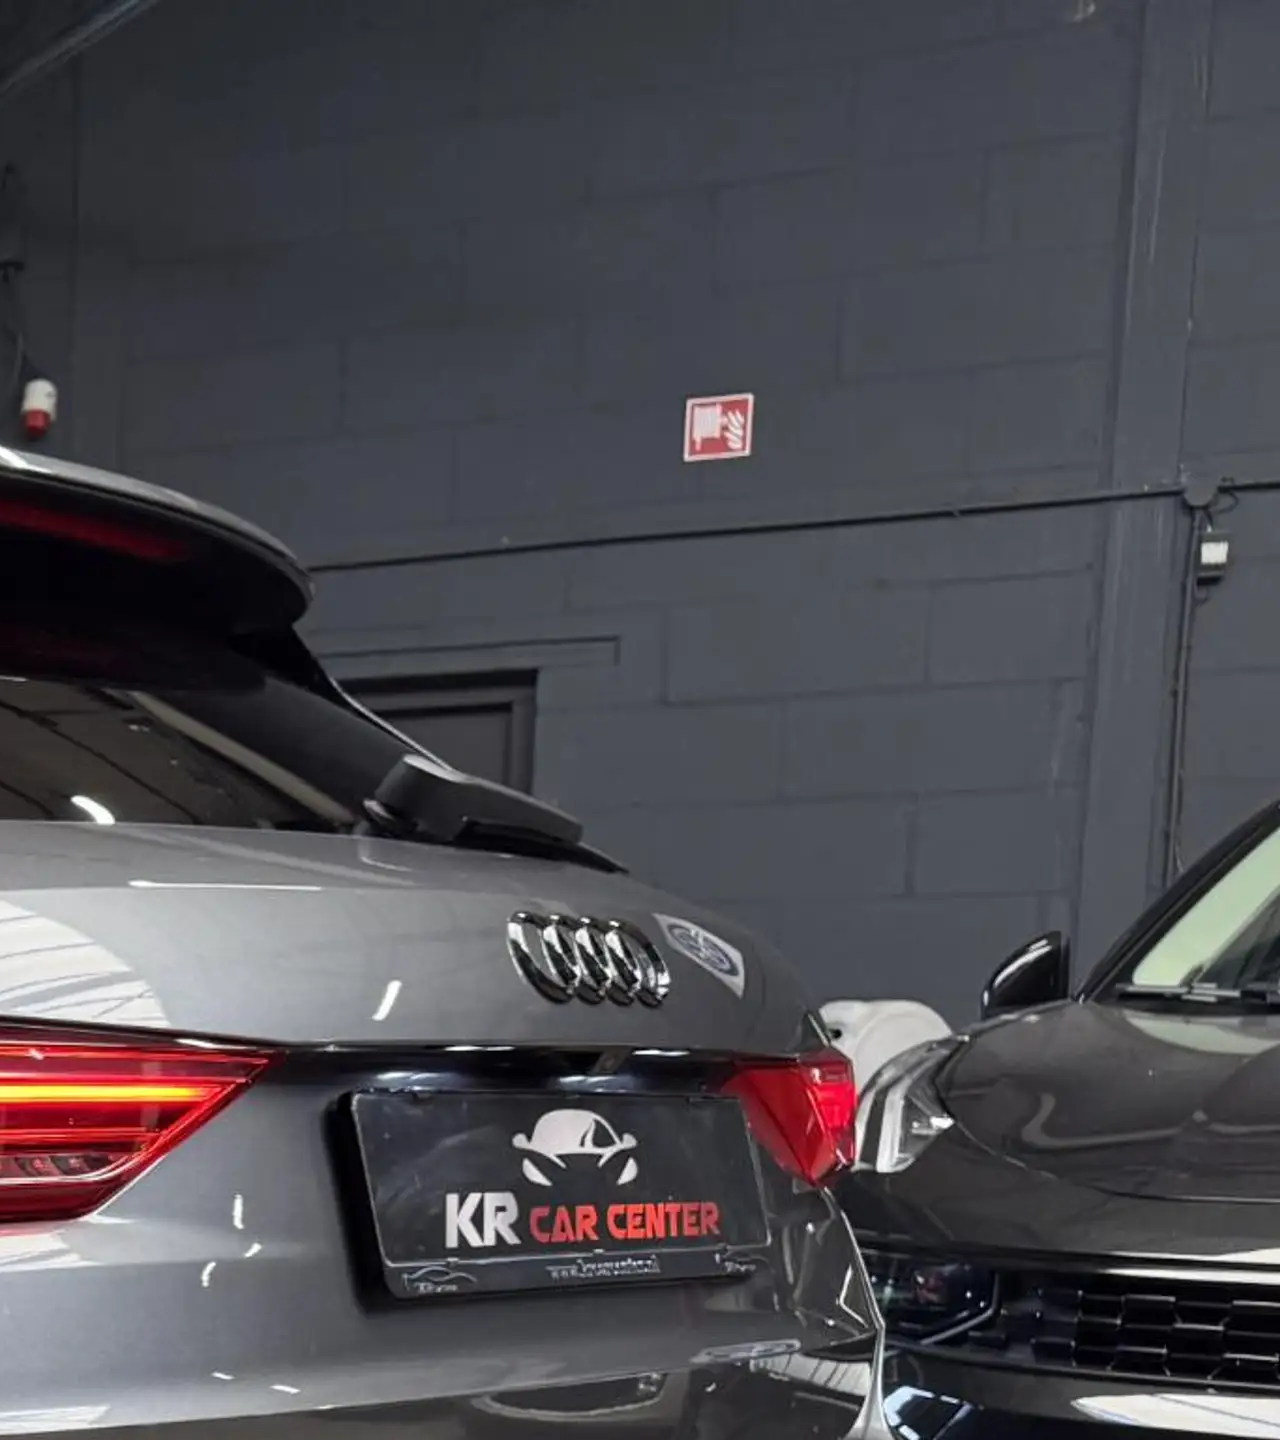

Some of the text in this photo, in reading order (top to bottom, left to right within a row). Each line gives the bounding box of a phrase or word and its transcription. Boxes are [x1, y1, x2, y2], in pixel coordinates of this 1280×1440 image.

[445, 1191, 721, 1248] KR CAR CENTER
